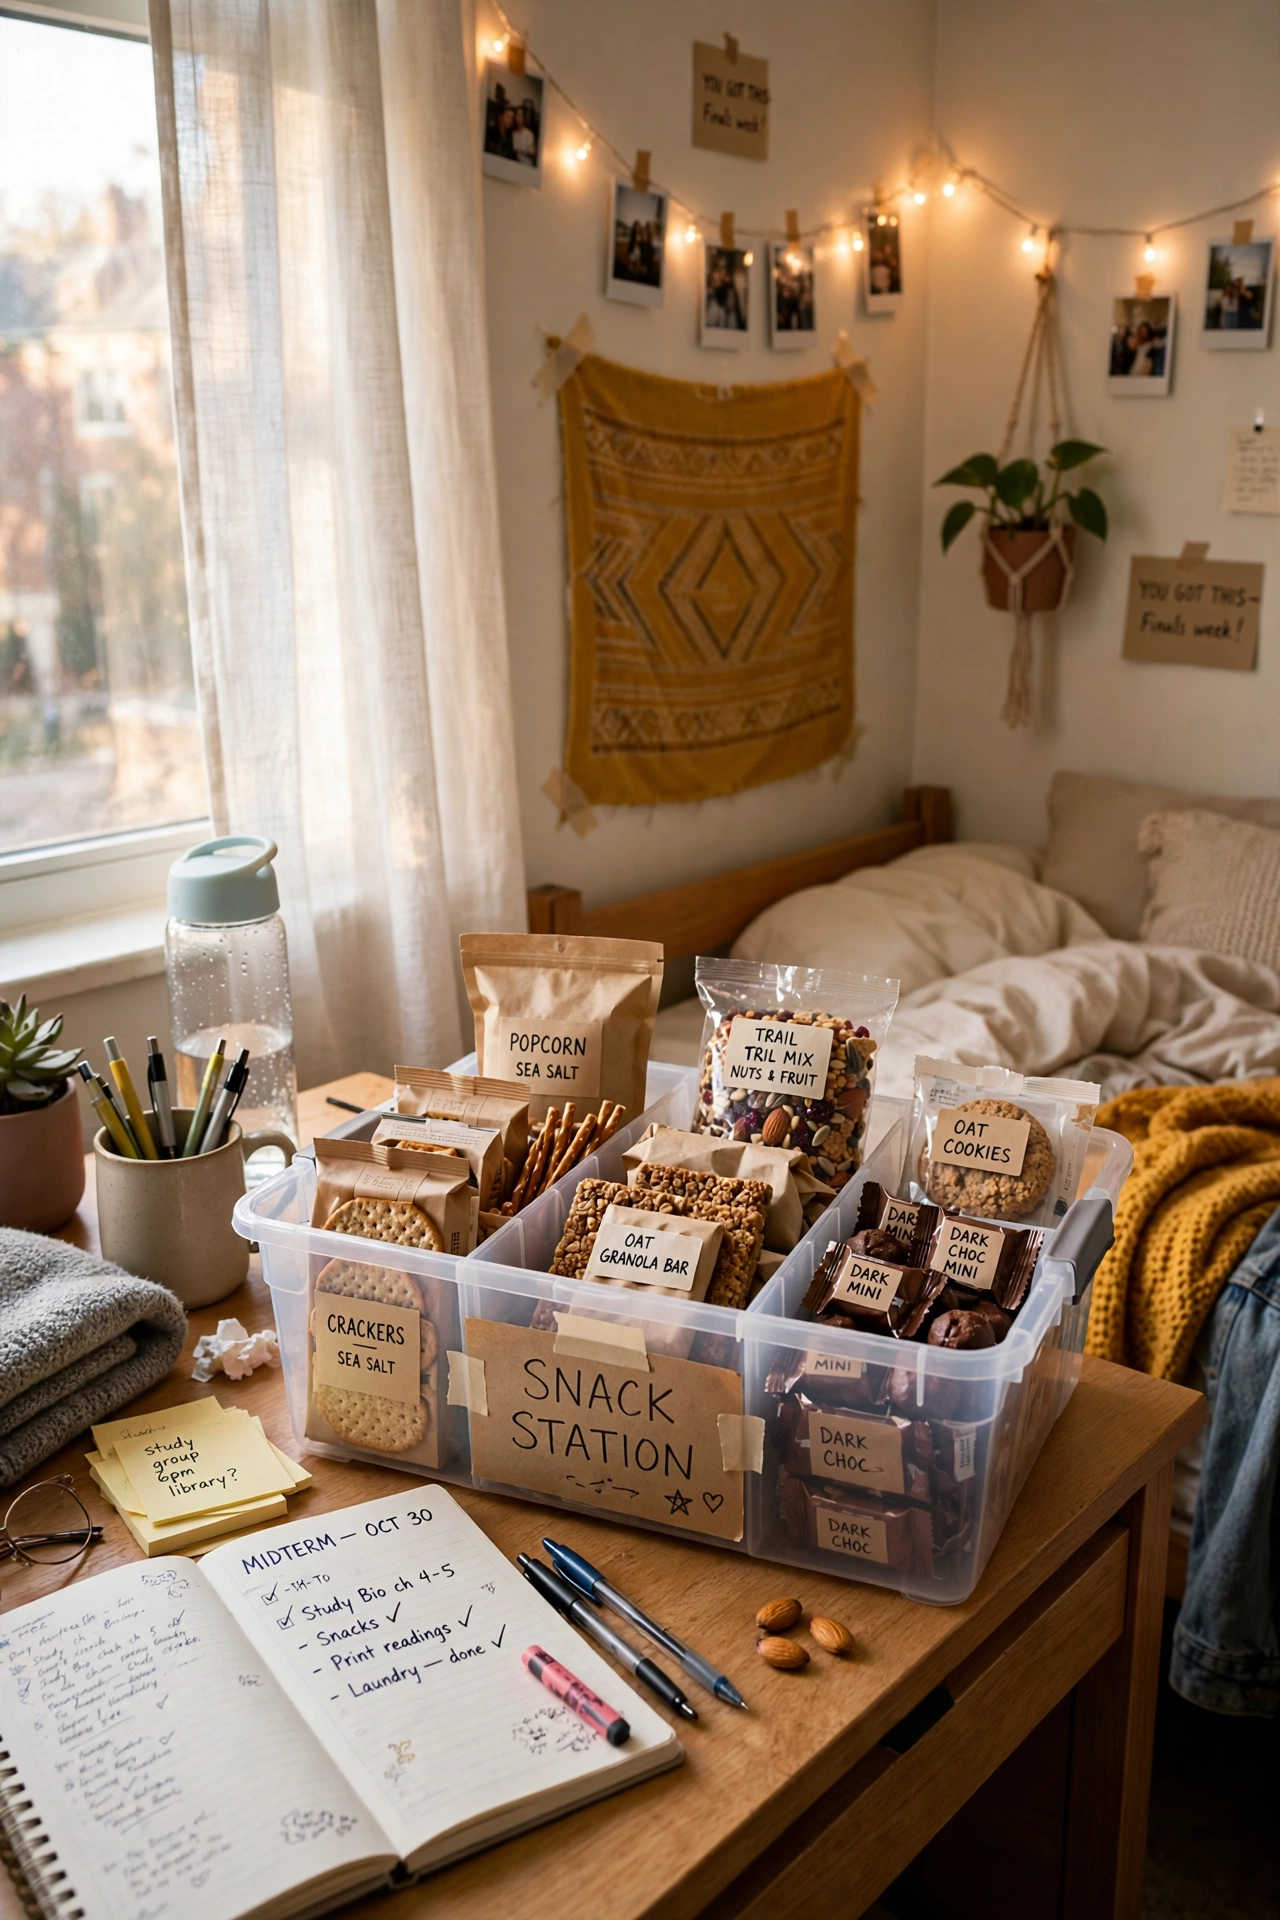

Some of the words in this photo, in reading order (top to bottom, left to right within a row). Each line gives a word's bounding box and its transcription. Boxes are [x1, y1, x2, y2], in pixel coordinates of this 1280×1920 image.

[1139, 579, 1169, 601] YOU
[1174, 583, 1204, 602] GOT
[510, 1032, 586, 1056] POPCORN
[755, 1028, 798, 1046] TRAIL
[744, 1046, 776, 1063] TRIL
[783, 1050, 814, 1067] MIX
[515, 1061, 541, 1078] SEA
[546, 1064, 579, 1080] SALT
[730, 1065, 762, 1080] NUTS
[767, 1069, 775, 1082] &
[780, 1070, 818, 1087] FRUIT
[954, 1119, 989, 1138] OAT
[943, 1138, 1011, 1163] COOKIES
[888, 1206, 919, 1226] DAR
[624, 1233, 655, 1249] OAT
[885, 1224, 914, 1241] MIN
[950, 1226, 989, 1248] DARK
[599, 1248, 658, 1270] GRANOLA
[663, 1258, 689, 1276] BAR
[948, 1244, 986, 1264] CHOC
[850, 1263, 890, 1287] DARK
[943, 1260, 978, 1280] MINI
[846, 1281, 882, 1300] MINI
[327, 1313, 405, 1345] CRACKERS
[337, 1350, 361, 1369] SEA
[366, 1357, 396, 1374] SALT
[815, 1360, 851, 1371] MINI
[523, 1358, 675, 1424] SNACK
[144, 1436, 193, 1456] study
[512, 1410, 693, 1480] STATION
[820, 1426, 868, 1450] DARK
[153, 1451, 199, 1471] group
[823, 1450, 870, 1473] CHOC
[156, 1467, 194, 1485] 6pm
[828, 1517, 872, 1538] DARK
[241, 1533, 337, 1575] MIDTERM
[365, 1516, 401, 1537] OCT
[407, 1508, 433, 1526] 30
[832, 1536, 872, 1554] CHOC
[301, 1597, 355, 1621] Study
[357, 1587, 386, 1603] Bio
[394, 1577, 414, 1592] ch
[316, 1618, 380, 1646] Snacks
[330, 1648, 376, 1671] Print
[383, 1622, 452, 1654] readings
[348, 1665, 422, 1698] Laundry
[449, 1643, 486, 1664] done
